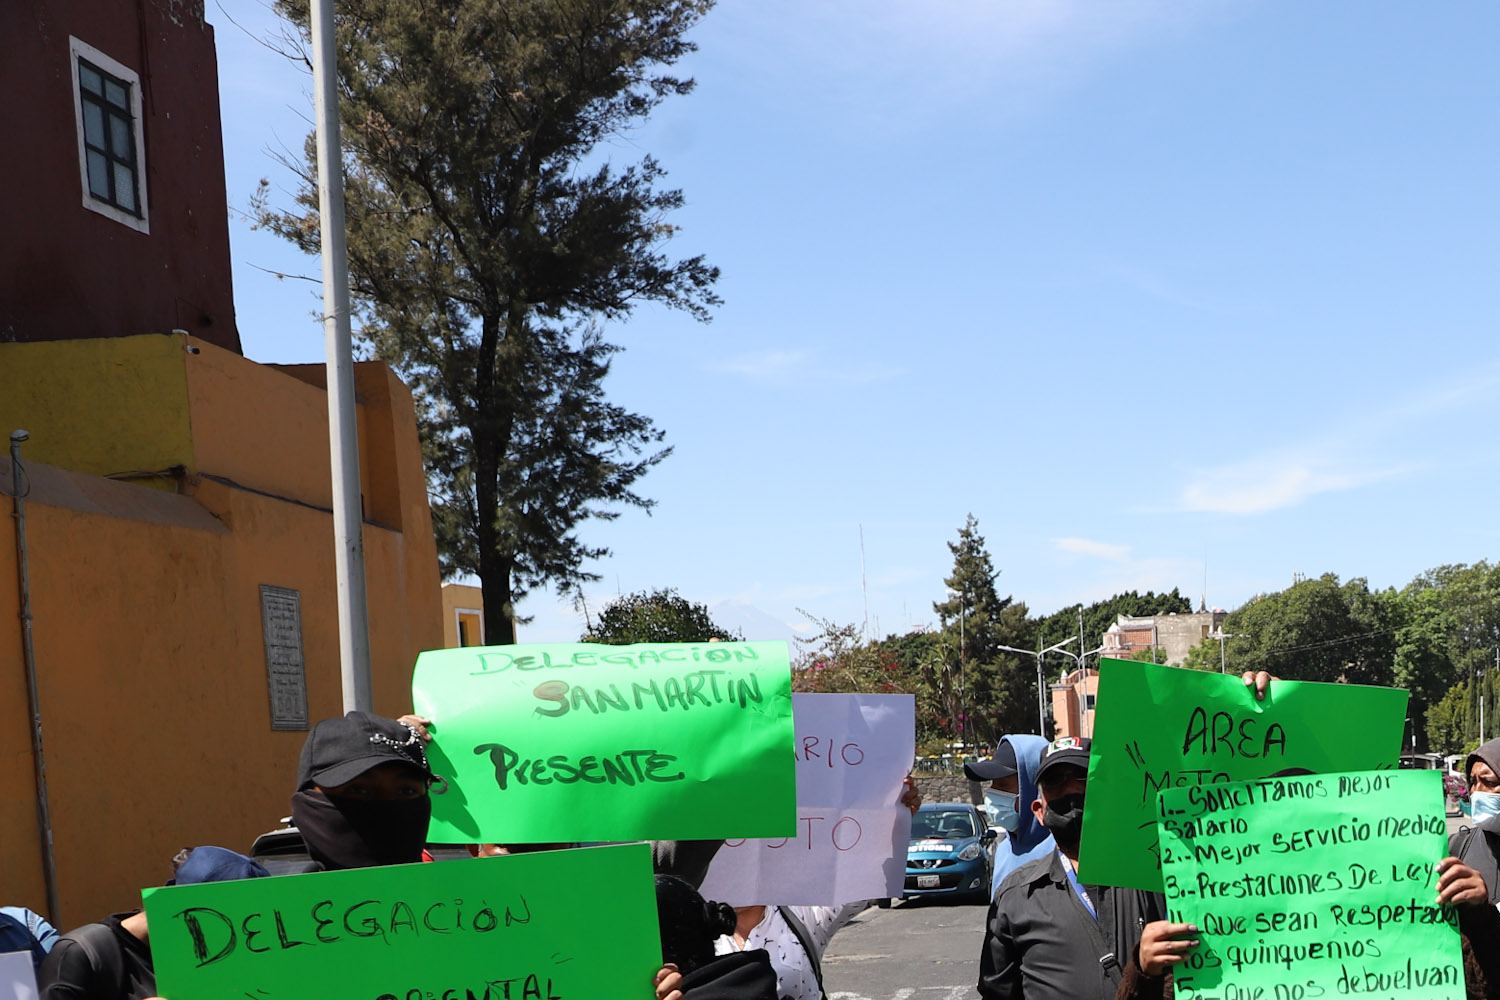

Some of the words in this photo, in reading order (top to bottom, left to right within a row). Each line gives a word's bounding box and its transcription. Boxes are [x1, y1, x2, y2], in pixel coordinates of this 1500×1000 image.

[1182, 706, 1286, 758] AREA
[1227, 933, 1382, 972] quinquenios
[1337, 957, 1458, 995] debuelvan
